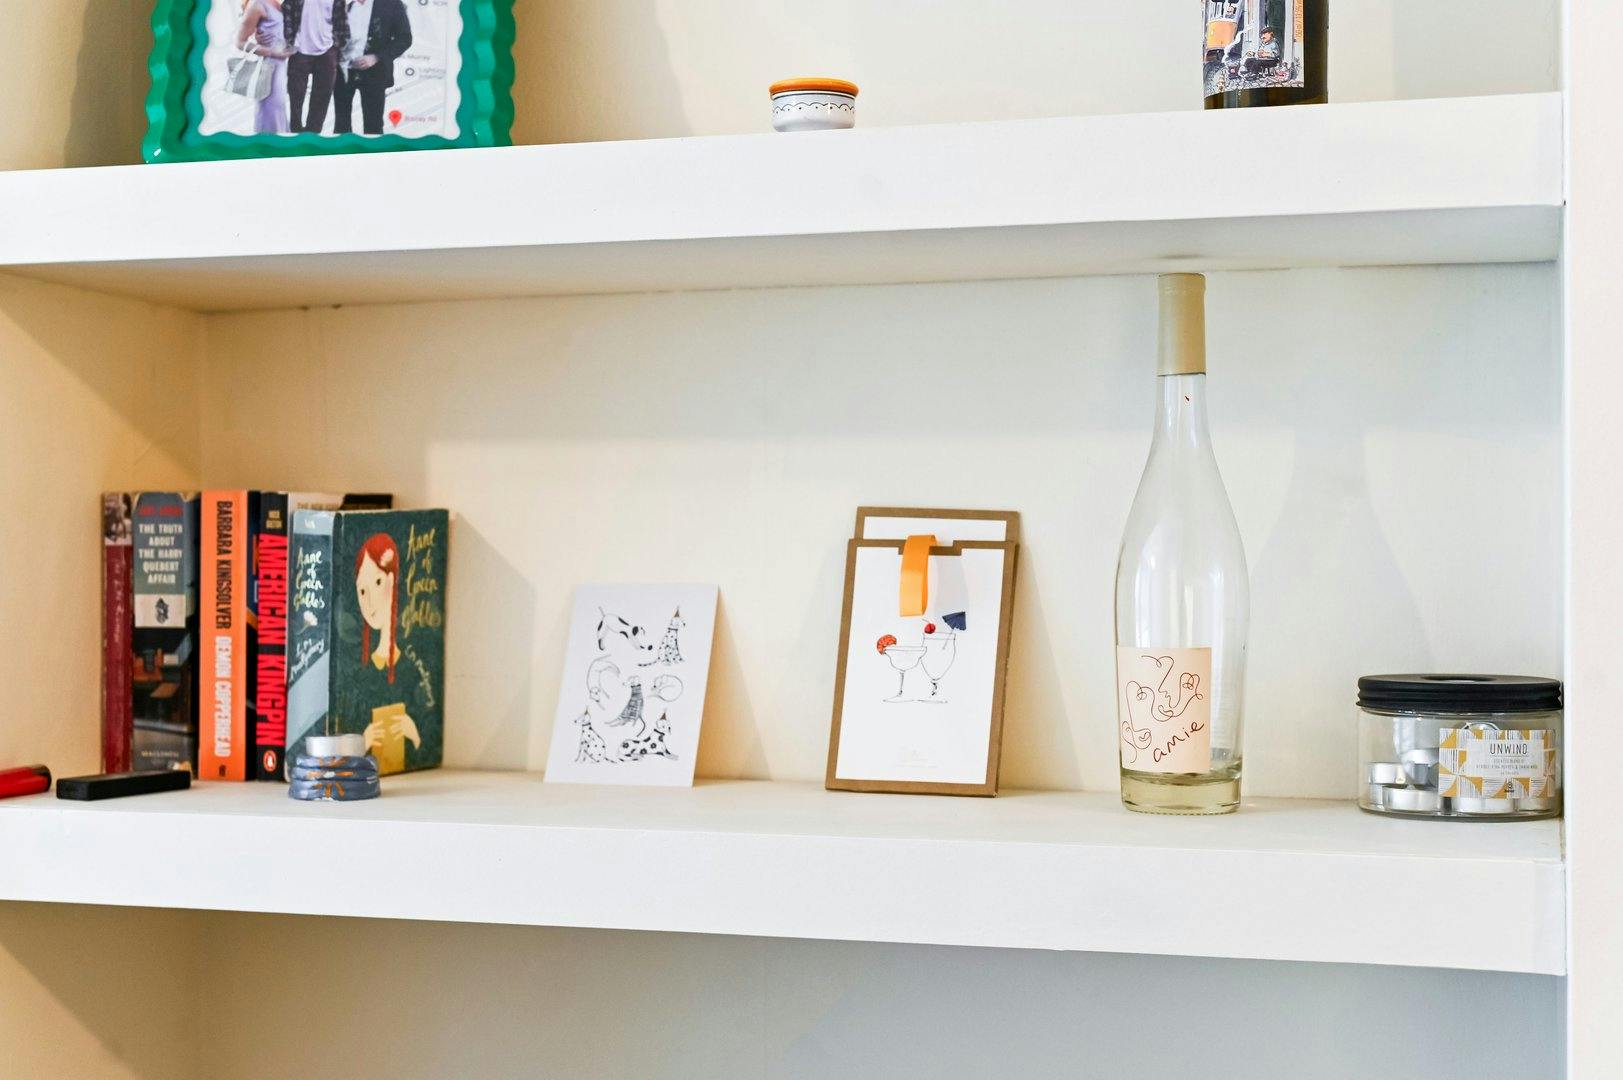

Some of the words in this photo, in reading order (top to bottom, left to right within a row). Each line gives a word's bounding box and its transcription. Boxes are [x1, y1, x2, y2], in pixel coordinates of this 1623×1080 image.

[139, 524, 155, 533] THE
[148, 536, 175, 547] ABOUT
[216, 501, 233, 556] BARBARA
[406, 523, 436, 562] Anne
[139, 549, 155, 559] THE
[296, 546, 323, 569] Anne
[422, 548, 433, 575] of
[147, 574, 176, 584] AFFAIR
[216, 559, 232, 630] KINGSOLVER
[258, 533, 288, 644] AMERICAN
[295, 568, 324, 594] Green
[406, 562, 438, 597] Green
[293, 590, 325, 612] Gables
[401, 596, 442, 639] Gables
[214, 635, 232, 678] DEMON
[256, 654, 288, 747] KINGPIN
[214, 681, 232, 757] COPPERHEAD
[1153, 721, 1205, 763] amie
[1489, 743, 1528, 755] UNWIND
